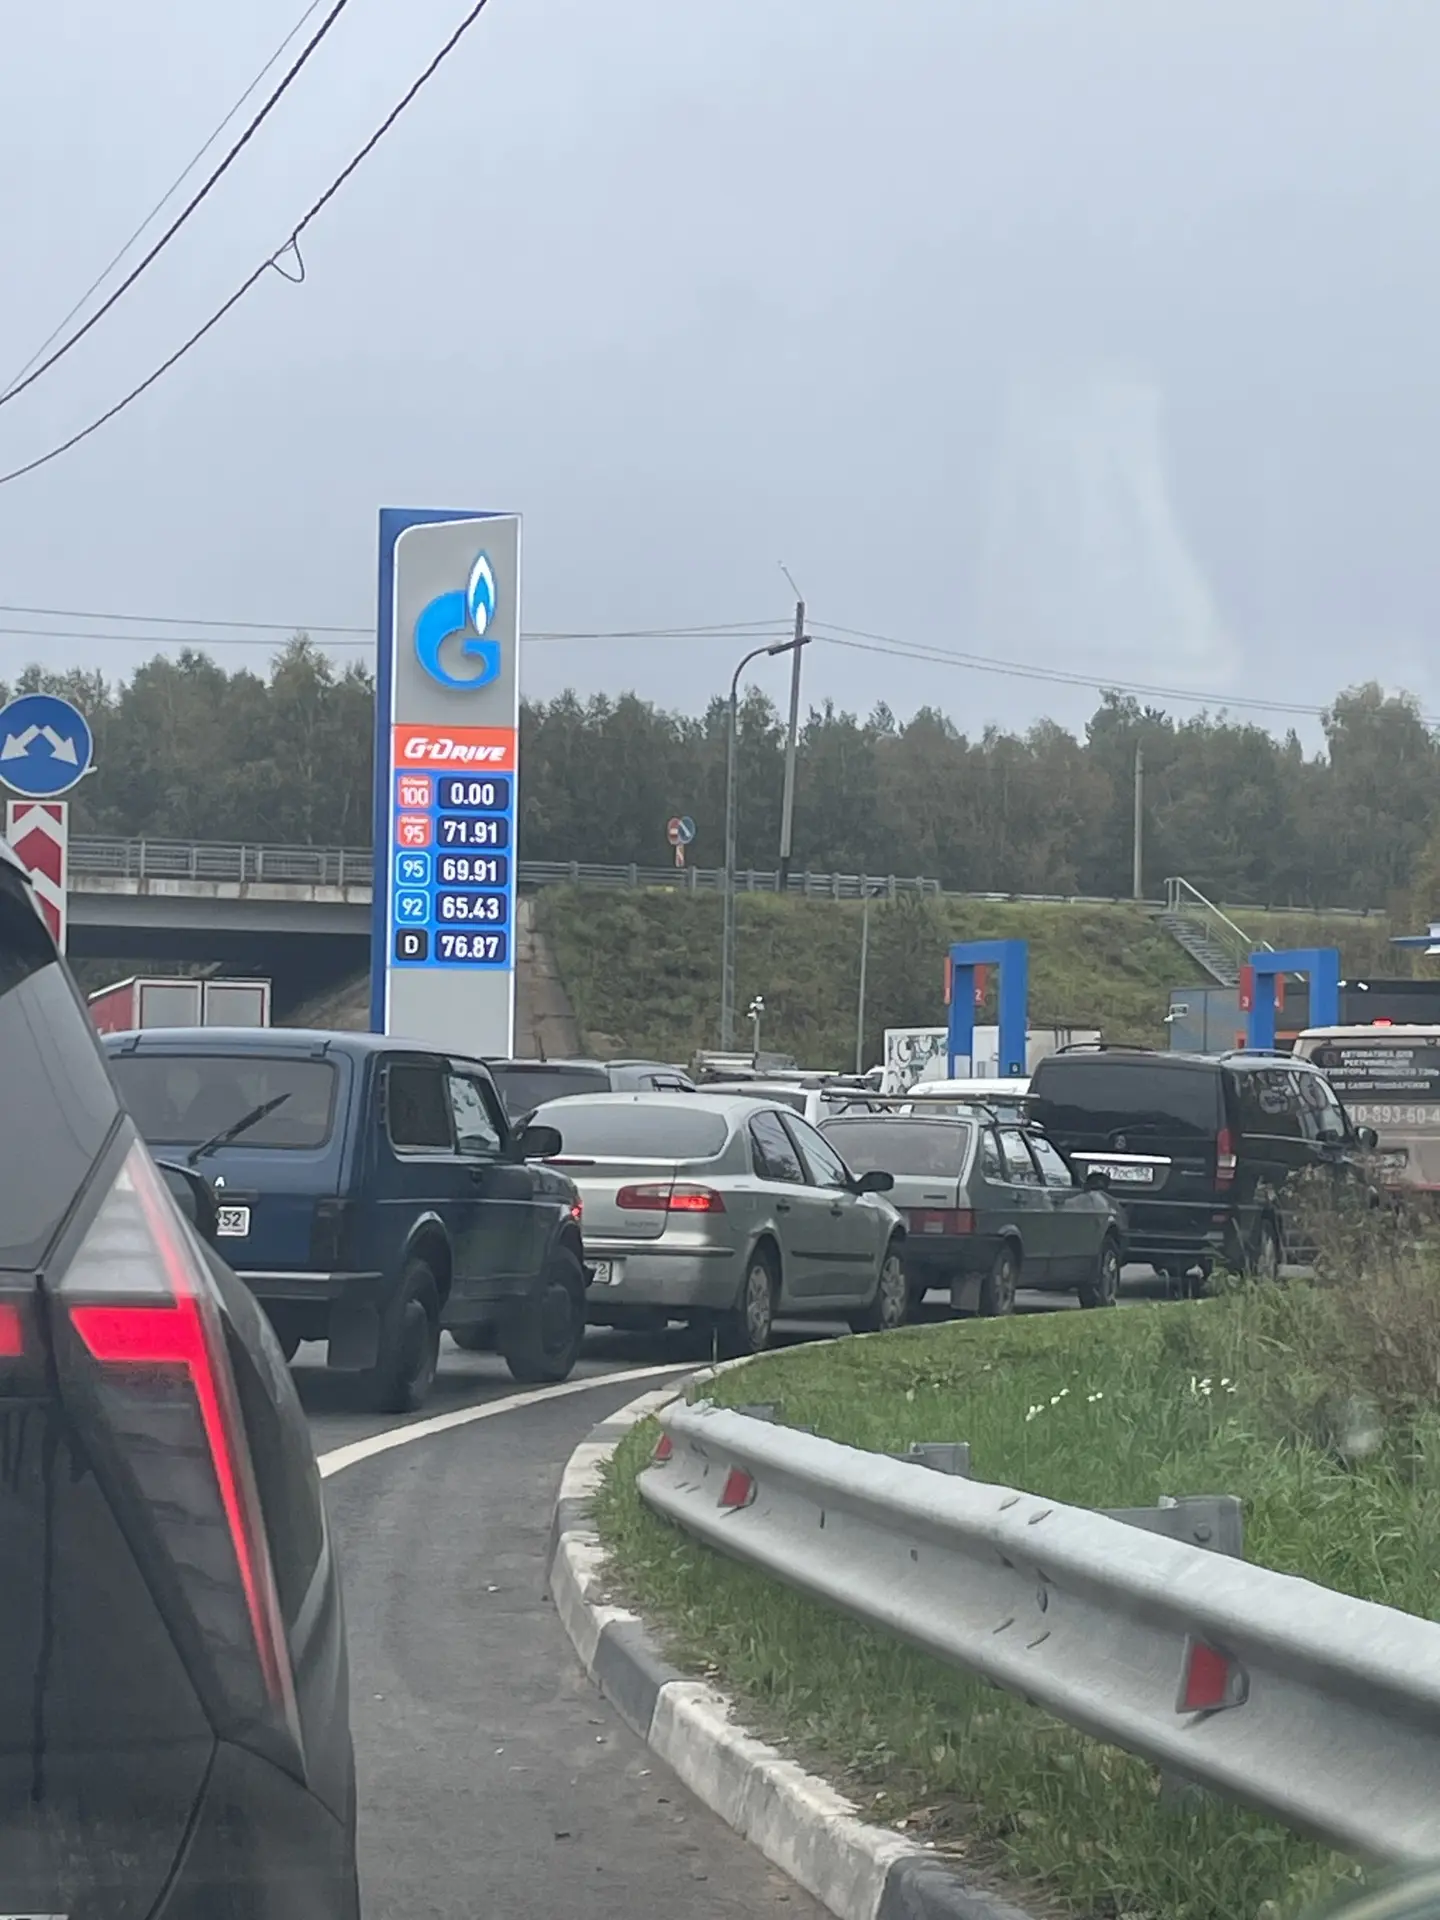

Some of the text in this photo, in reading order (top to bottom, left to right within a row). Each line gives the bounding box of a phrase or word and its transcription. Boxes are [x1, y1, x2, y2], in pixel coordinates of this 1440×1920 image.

[401, 782, 495, 805] 100 0.00
[403, 820, 498, 844] 95 71.91
[402, 858, 497, 881] 95 69.91
[401, 896, 499, 919] 92 65.43
[404, 935, 499, 958] D 76.87
